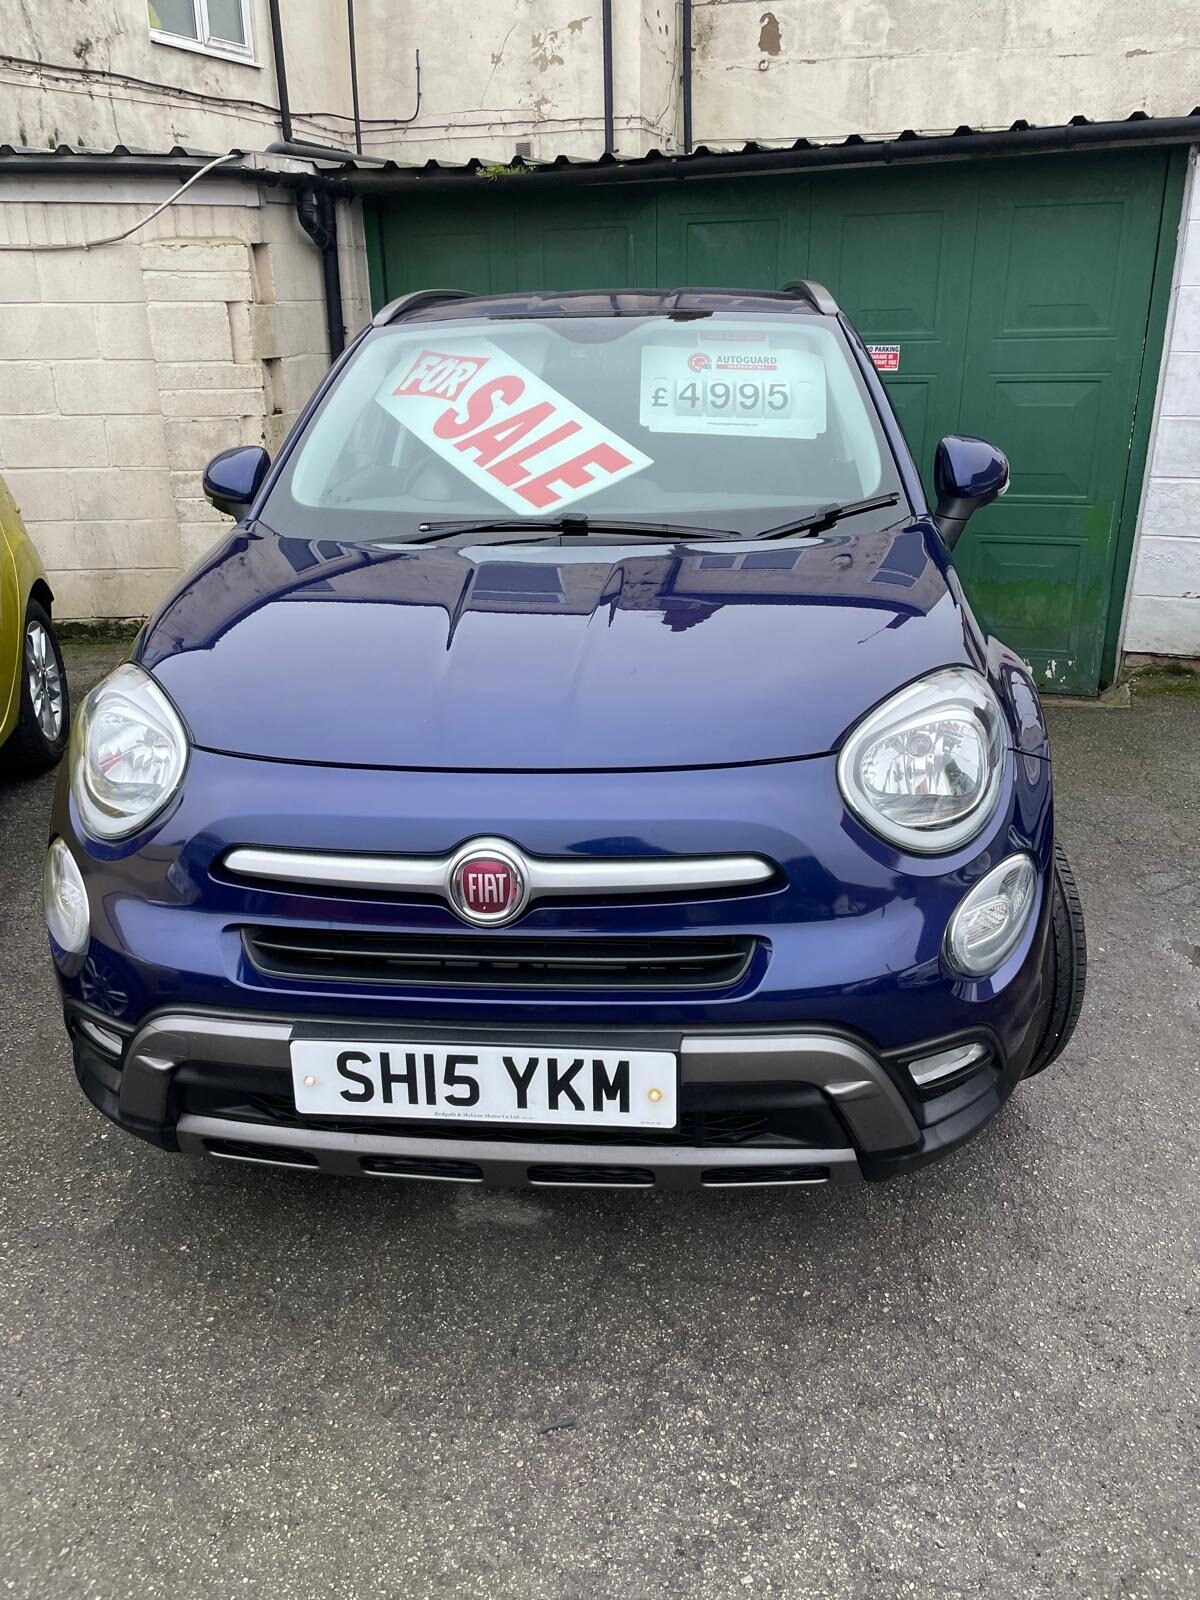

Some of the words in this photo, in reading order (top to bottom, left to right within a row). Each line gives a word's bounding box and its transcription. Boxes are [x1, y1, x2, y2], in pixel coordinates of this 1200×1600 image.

[400, 356, 478, 396] FOR
[716, 355, 777, 365] AUTOGUARD
[432, 375, 633, 509] SALE
[468, 873, 507, 903] FIAT
[336, 1050, 480, 1107] SH15
[502, 1056, 630, 1113] YKM
